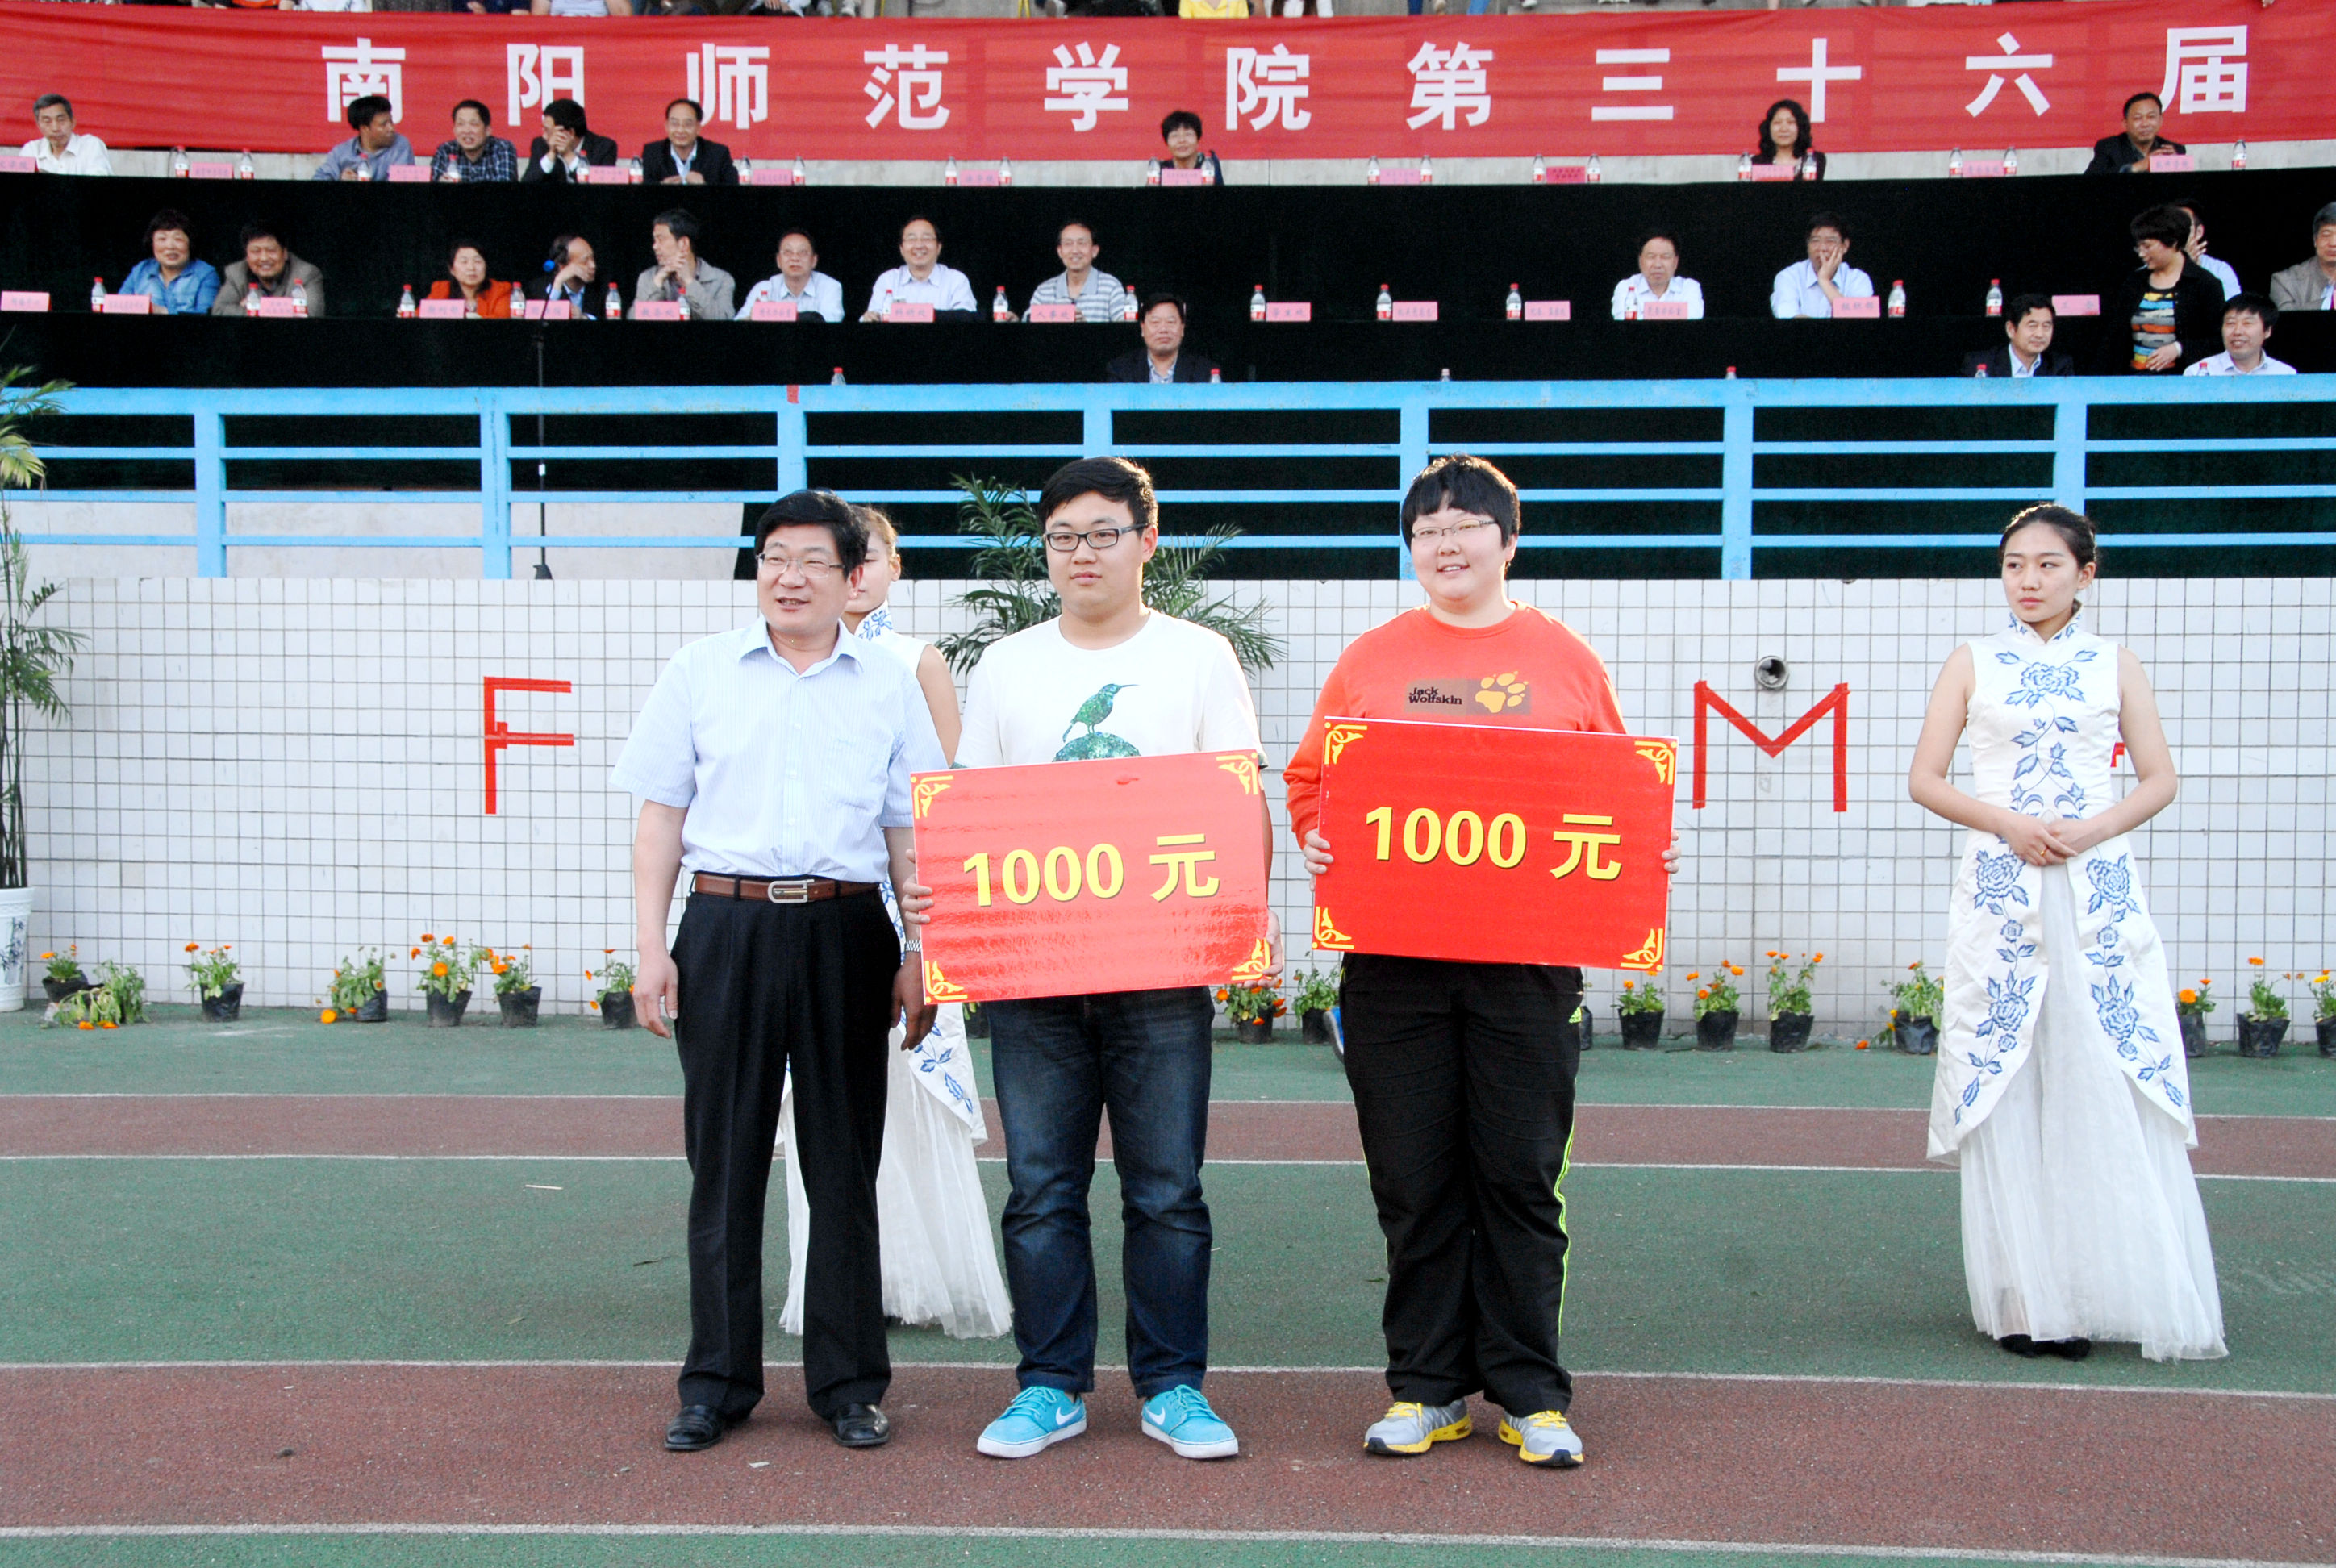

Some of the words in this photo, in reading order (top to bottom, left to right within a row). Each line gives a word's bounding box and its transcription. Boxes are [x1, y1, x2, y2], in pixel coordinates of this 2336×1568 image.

[321, 24, 2250, 133] 南阳师范学院第三十六届
[1408, 694, 1462, 705] Wolfskin
[1409, 686, 1439, 696] Jack
[484, 676, 574, 815] F
[1692, 680, 1850, 813] M
[962, 843, 1124, 907] 1000
[1149, 833, 1220, 902] 元
[1366, 806, 1528, 869] 1000
[1550, 813, 1621, 881] 元
